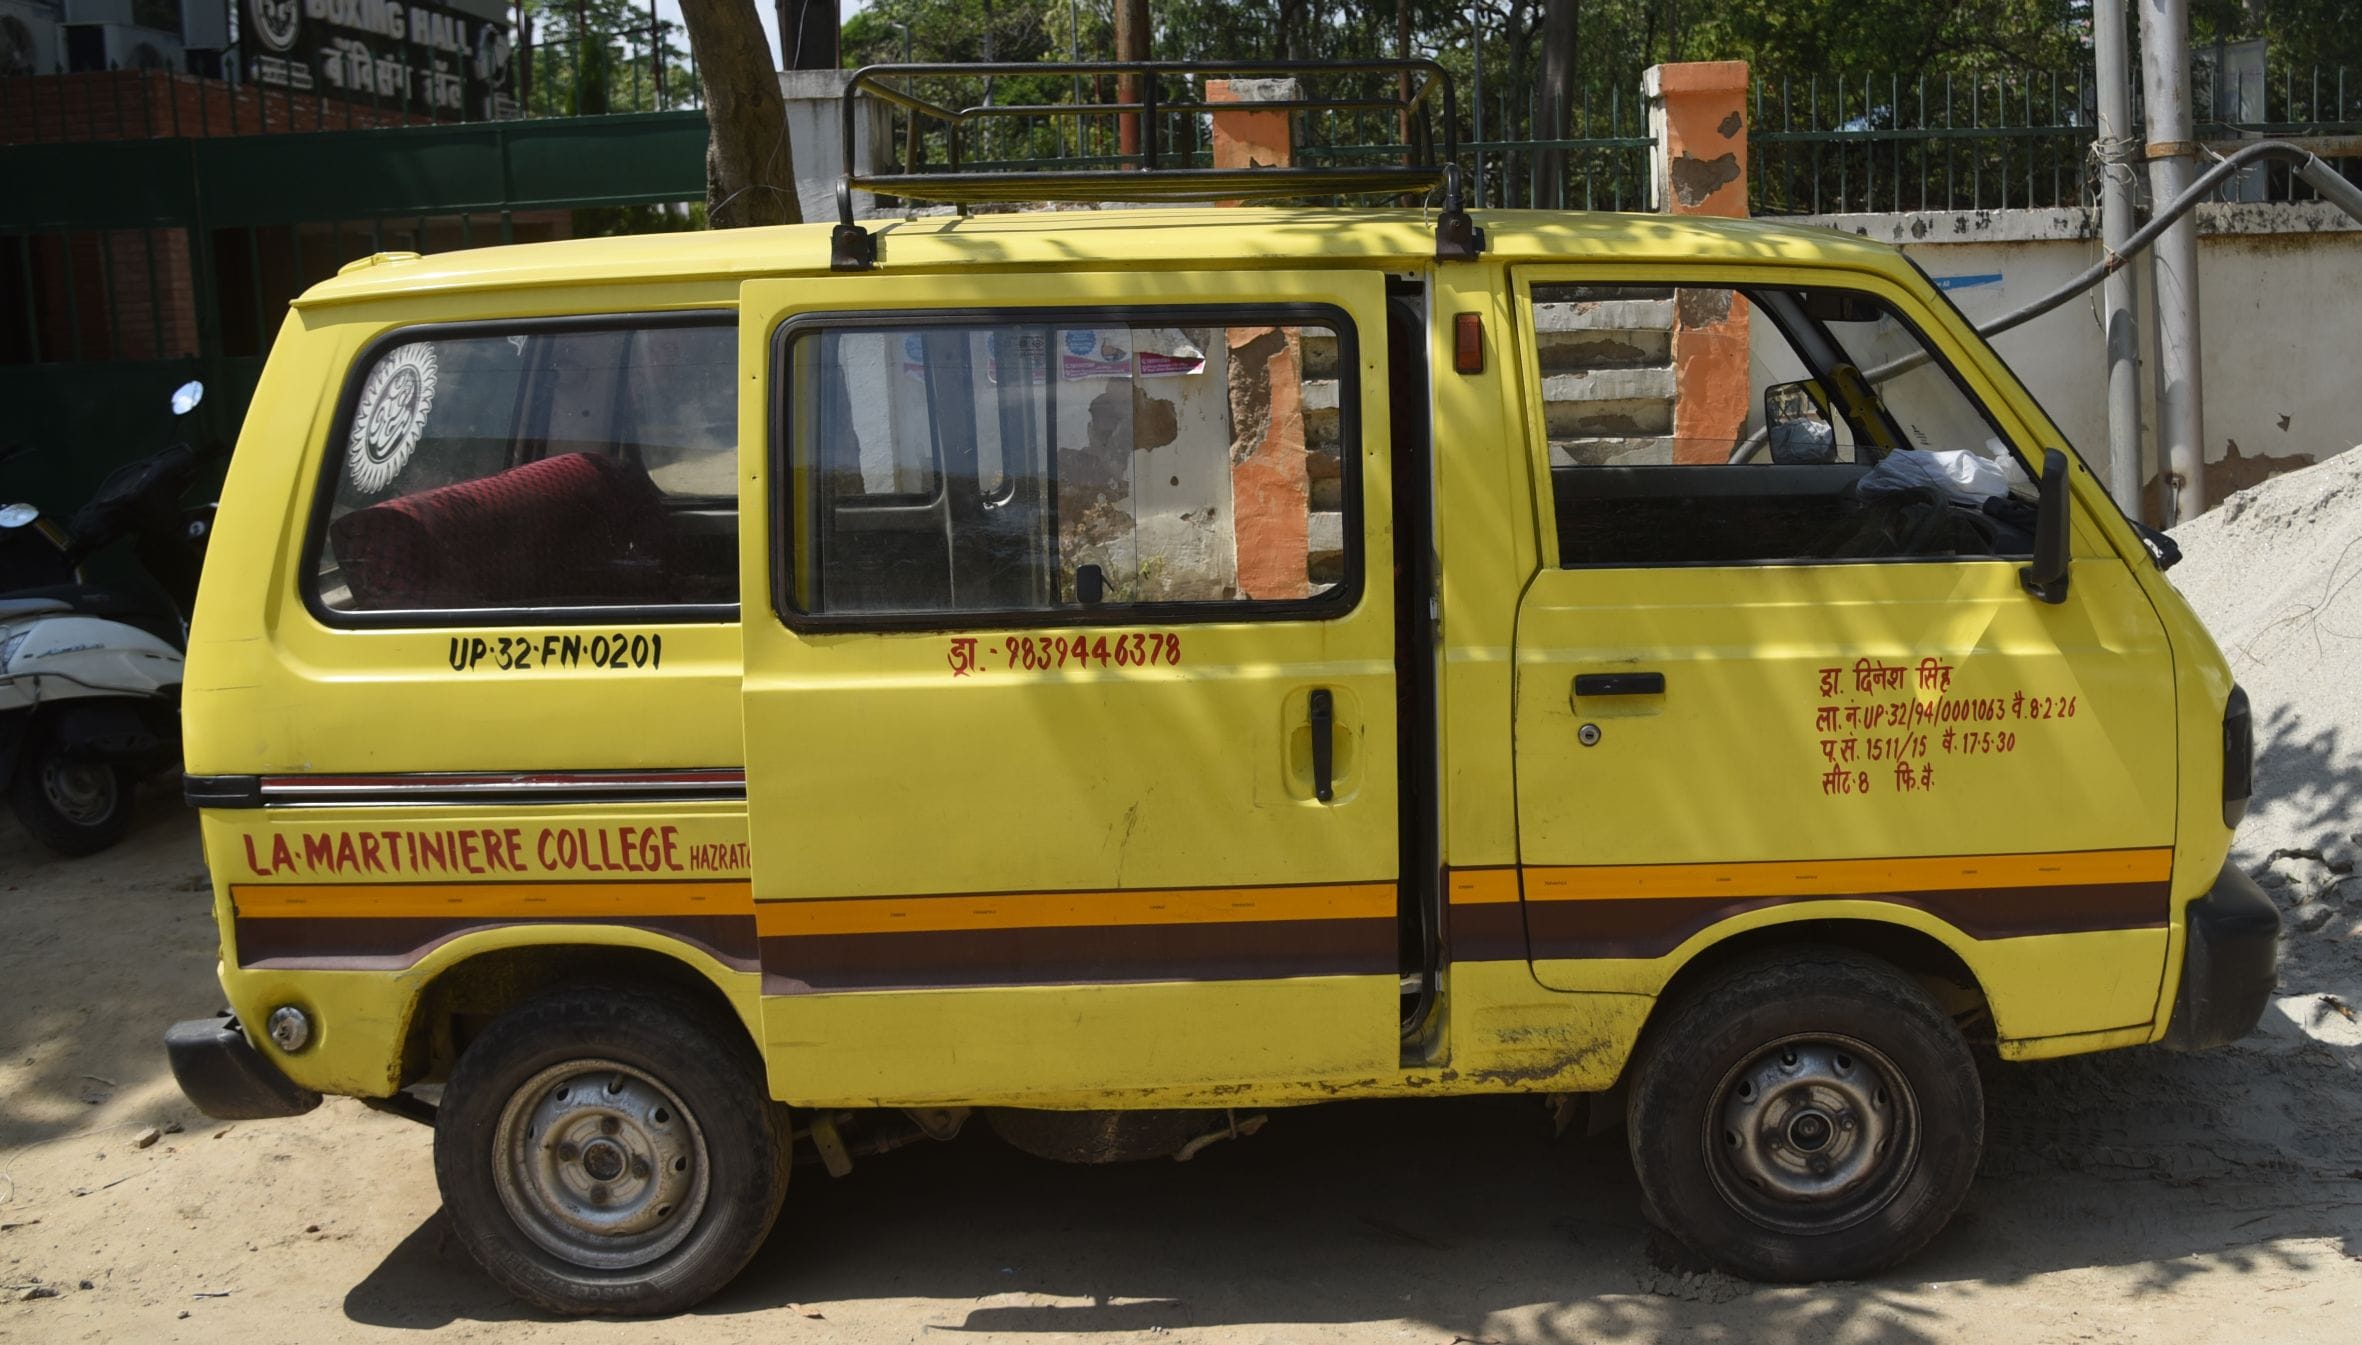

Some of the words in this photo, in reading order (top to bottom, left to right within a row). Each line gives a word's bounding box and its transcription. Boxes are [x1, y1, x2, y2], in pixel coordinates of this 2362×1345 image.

[409, 6, 473, 56] HALL
[1005, 632, 1181, 670] 9839446378
[1852, 658, 1908, 696] दिनेश
[1914, 657, 1954, 692] सिंह
[537, 826, 685, 872] COLLEGE
